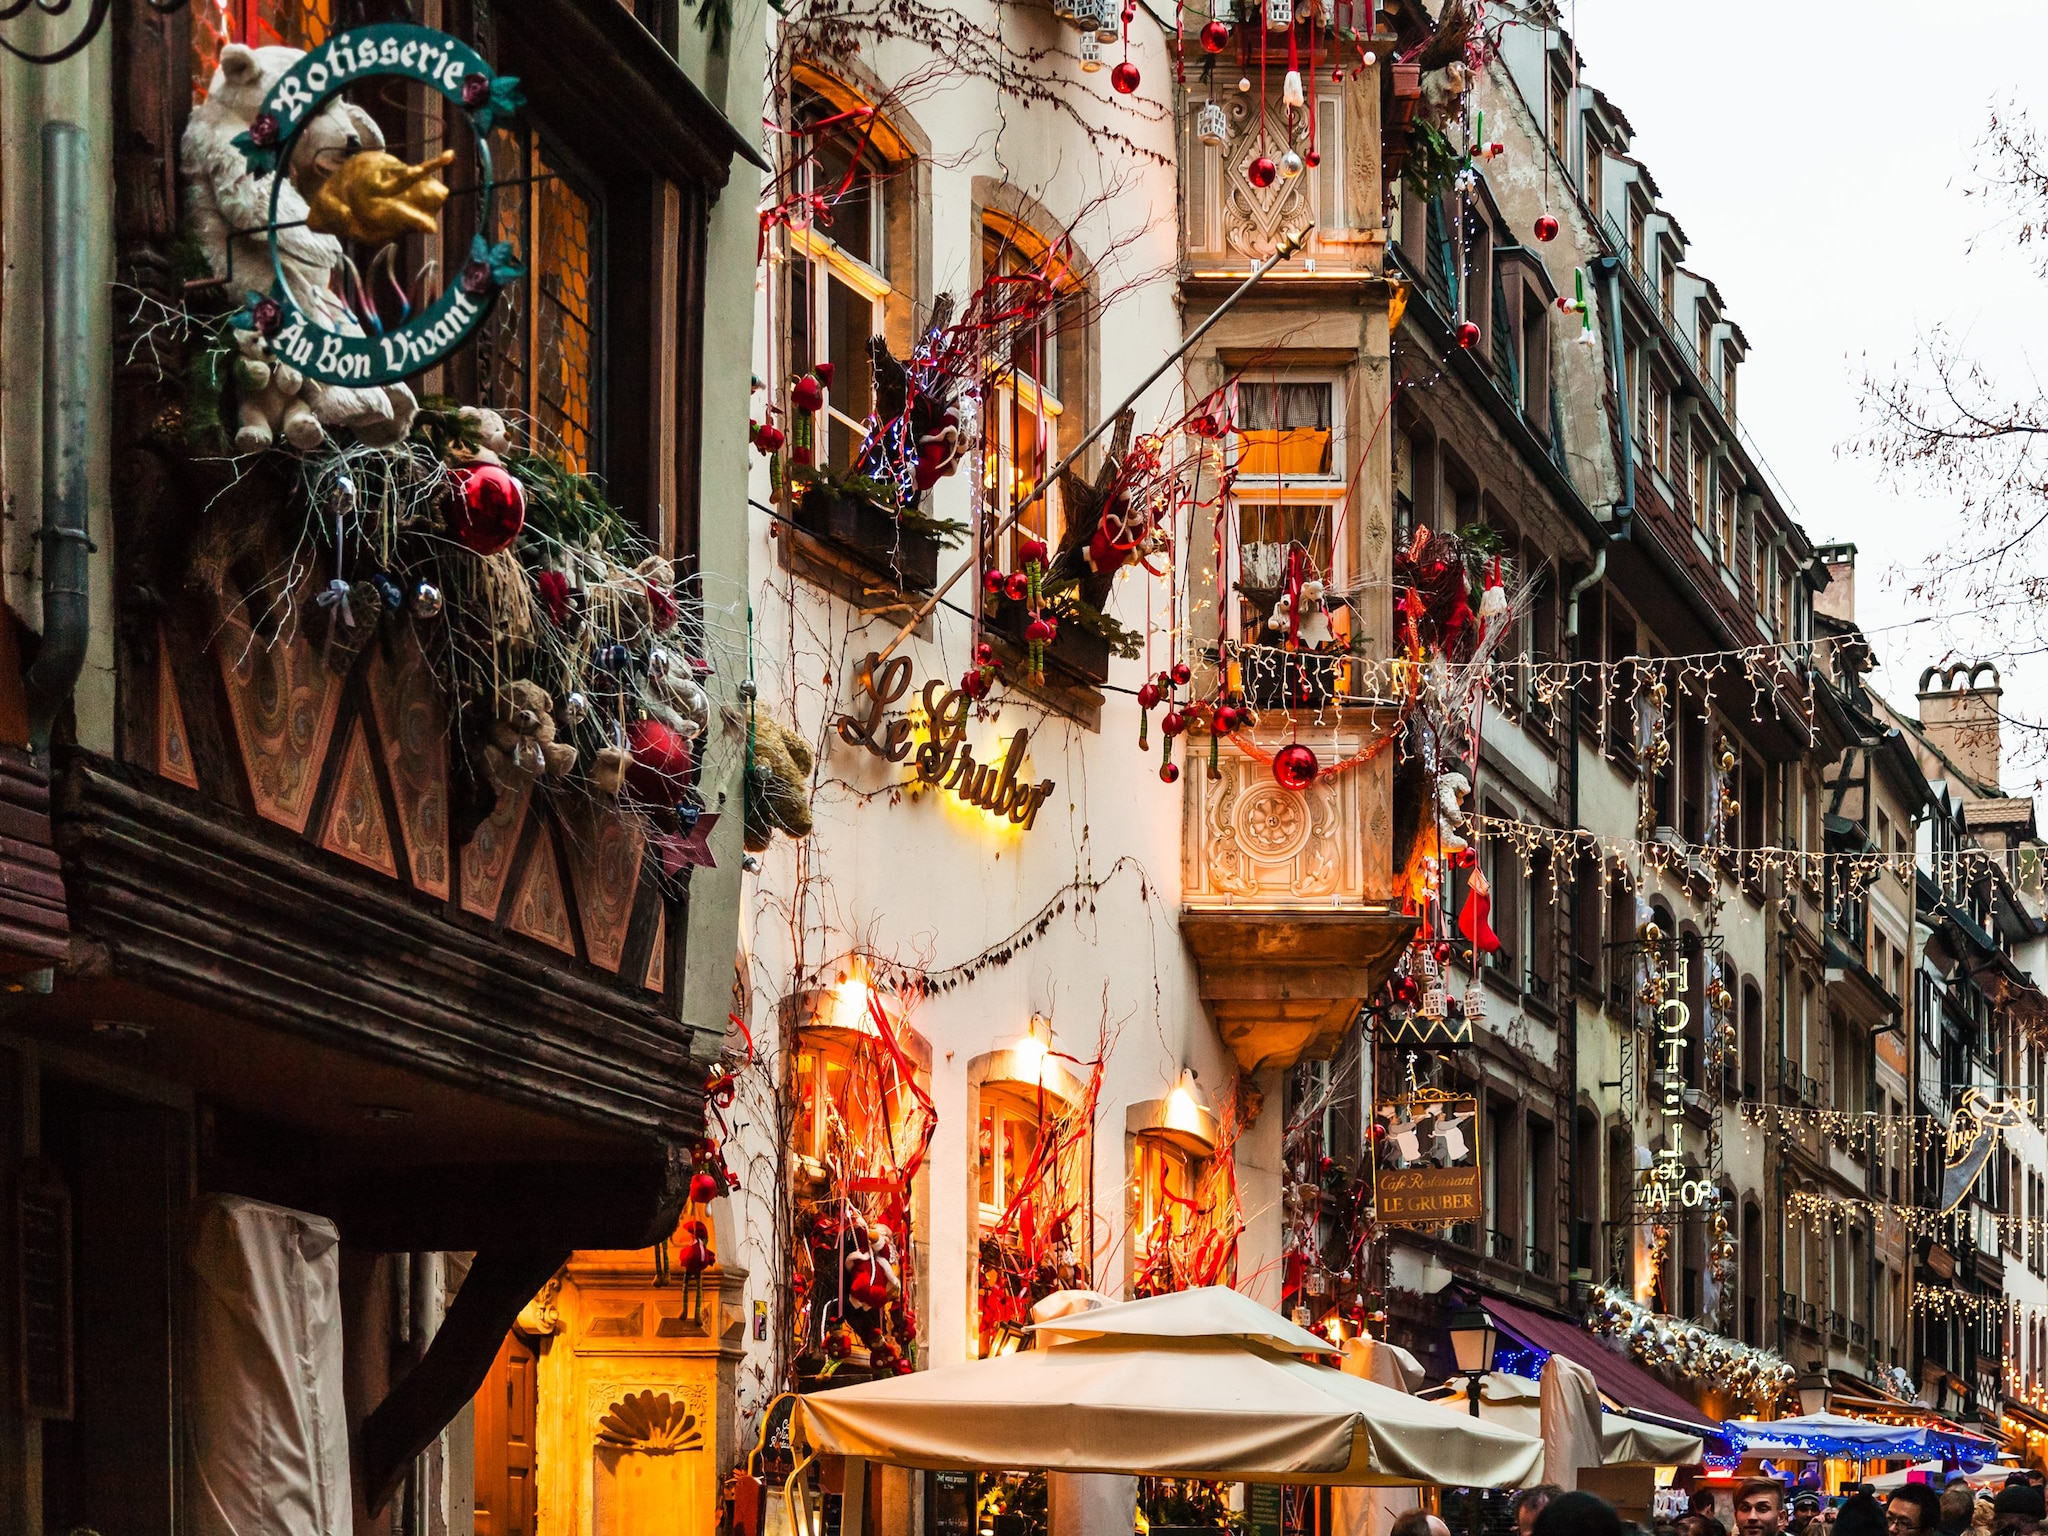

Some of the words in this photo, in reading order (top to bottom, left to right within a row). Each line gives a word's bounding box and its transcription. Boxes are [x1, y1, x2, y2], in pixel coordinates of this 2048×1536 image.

[270, 34, 465, 121] Rotisserie
[315, 339, 371, 379] Bon
[380, 287, 478, 372] Vivant
[837, 652, 913, 763] Le
[915, 679, 1056, 831] Gruber
[1383, 1198, 1404, 1213] LE
[1408, 1194, 1474, 1211] GRUBER
[1408, 1172, 1475, 1190] Restaurant
